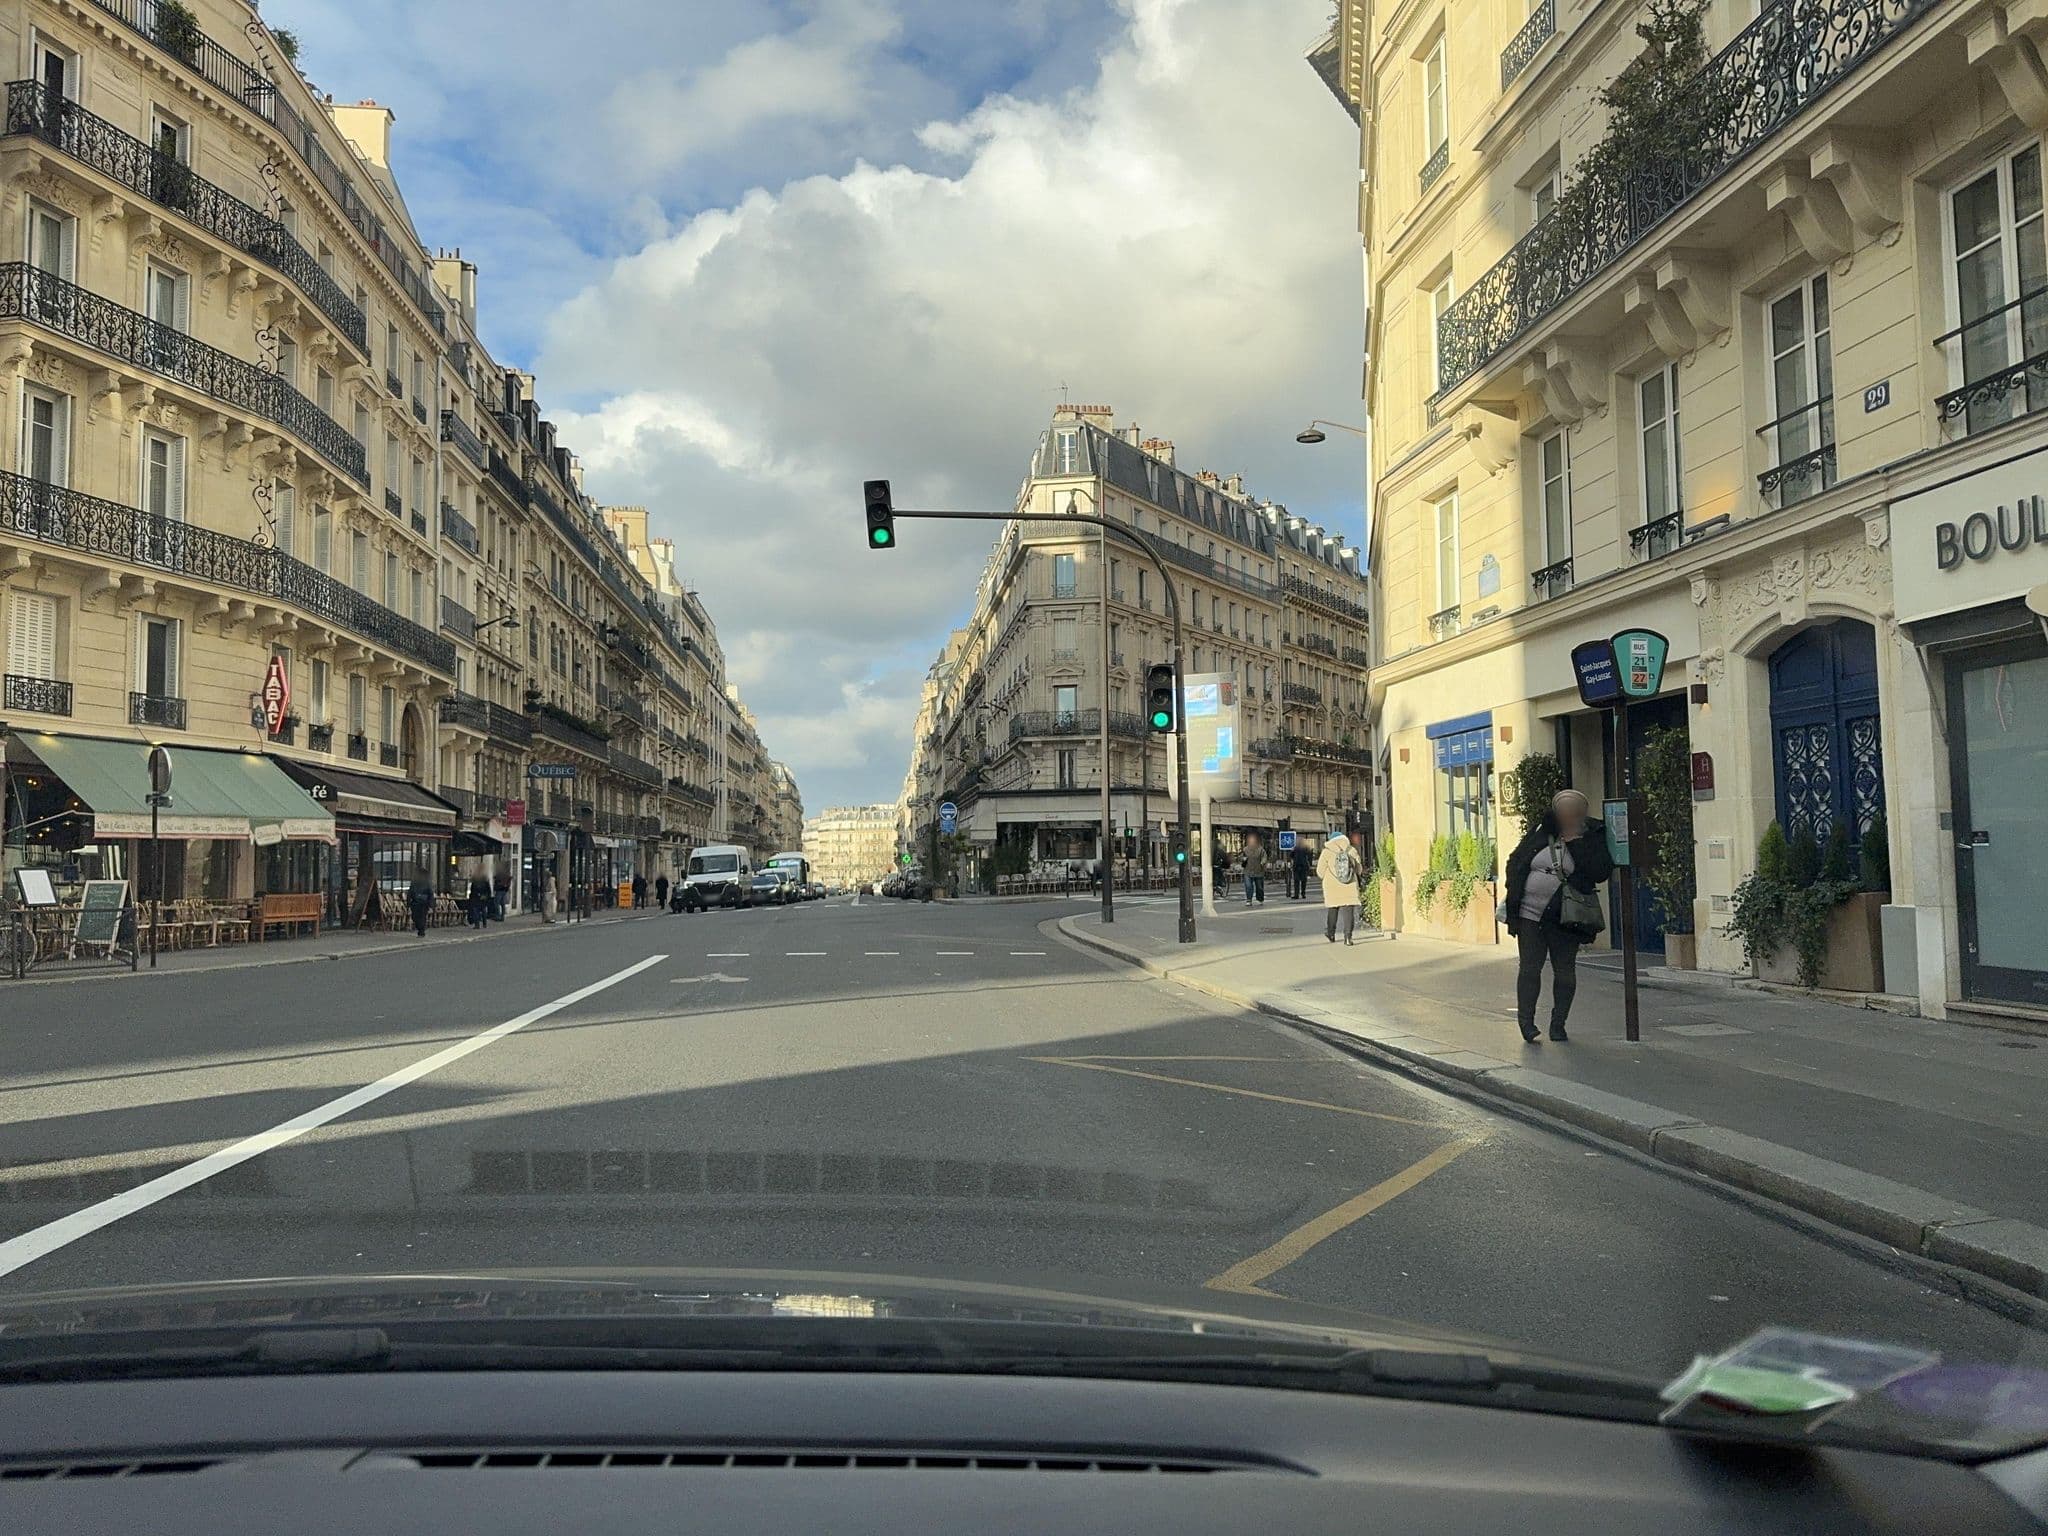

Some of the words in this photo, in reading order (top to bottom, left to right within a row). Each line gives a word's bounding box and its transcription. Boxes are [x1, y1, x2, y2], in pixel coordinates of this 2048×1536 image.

[1868, 385, 1886, 409] 29
[1936, 495, 2048, 569] BOUL
[1580, 660, 1611, 673] Saint-Jacques
[1634, 656, 1645, 666] 21
[1586, 672, 1611, 684] Gay-Lussac
[1633, 673, 1646, 683] 27
[266, 664, 282, 725] TABAC
[528, 764, 574, 776] QUÉBEC
